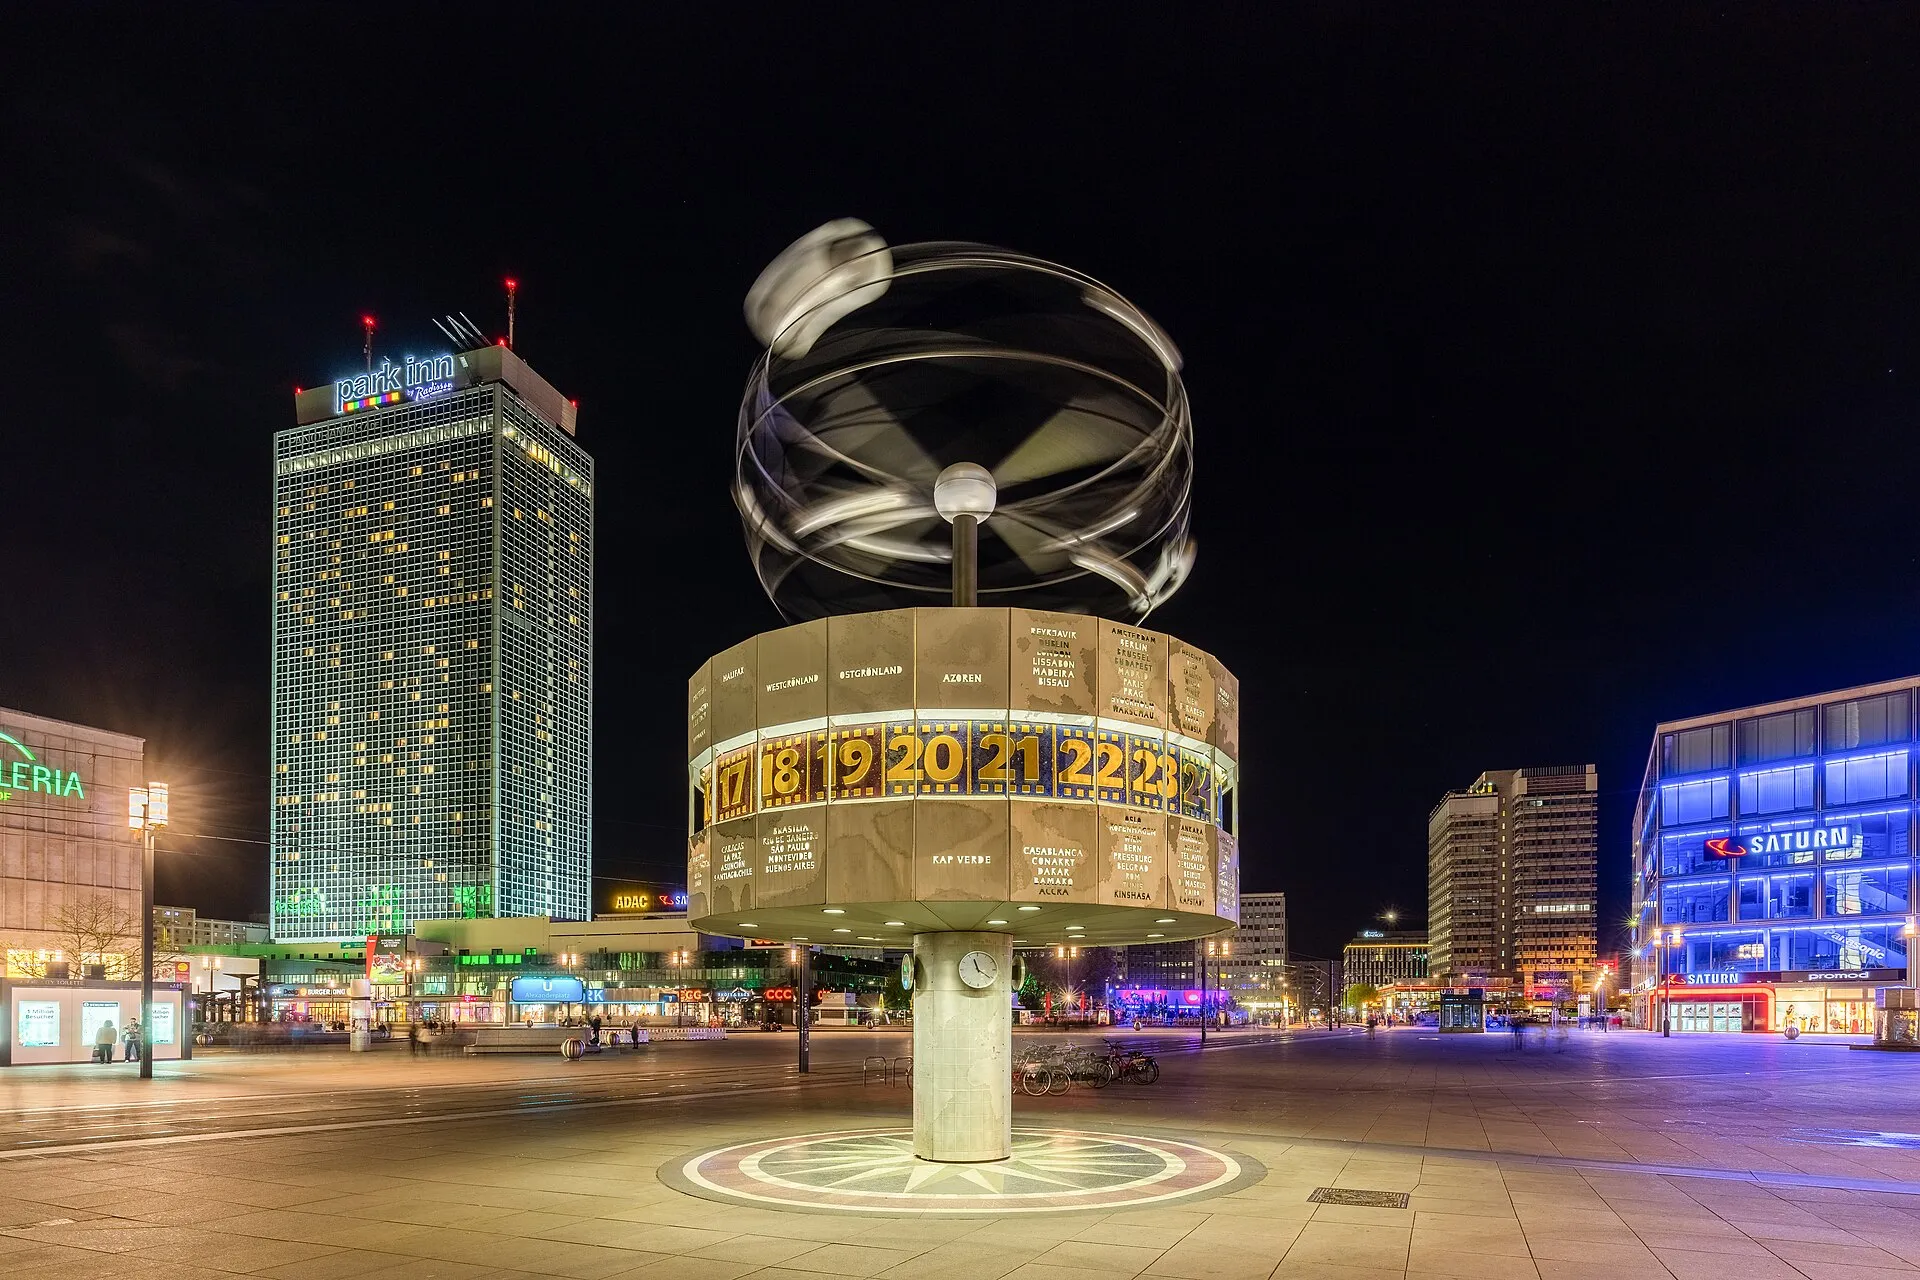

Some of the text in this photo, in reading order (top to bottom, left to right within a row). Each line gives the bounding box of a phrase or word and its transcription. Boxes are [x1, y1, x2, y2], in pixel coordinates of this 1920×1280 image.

[336, 355, 454, 413] park inn
[415, 382, 454, 401] Radisson
[1111, 627, 1156, 643] AMSTERDAM
[1039, 638, 1069, 648] DUBLIN
[1120, 639, 1148, 652] BERLIN
[1037, 650, 1071, 658] LONDON
[1032, 657, 1075, 669] LISSABON
[1114, 657, 1153, 672] BUDAPEST
[722, 667, 744, 682] HALIFAX
[839, 665, 903, 680] OSTGRÖNLAND
[942, 673, 982, 683] AZOREN
[1032, 667, 1075, 678] MADEIRA
[1118, 667, 1148, 680] MADRID
[766, 674, 819, 692] WESTGRÖNLAND
[1038, 677, 1070, 687] BISSAU
[1123, 677, 1144, 688] PARIS
[1123, 687, 1144, 698] PRAG
[1111, 695, 1155, 711] STOCKHOLM
[1112, 705, 1154, 719] WARSCHAU
[1180, 702, 1205, 718] BKAREST
[817, 739, 873, 787] 19
[886, 734, 963, 782] 20
[978, 734, 1040, 781] 21
[1058, 738, 1124, 789] 22
[762, 748, 800, 797] 18
[1132, 749, 1178, 799] 23
[720, 760, 747, 808] 17
[1109, 823, 1157, 836] KOPENHAGEN
[1181, 824, 1204, 835] ANKARA
[1751, 826, 1848, 853] SATURN
[771, 842, 810, 854] SÃO PAULO
[1023, 846, 1084, 857] CASABLANCA
[1124, 843, 1142, 853] BERN
[723, 851, 742, 863] LA PAZ
[768, 851, 813, 863] MONTEVIDEO
[932, 855, 991, 864] KAP VERDE
[1031, 857, 1075, 866] CONAKRY
[1113, 852, 1153, 864] PRESSBURG
[1181, 852, 1190, 860] TEL
[765, 861, 815, 873] BUENOS AIRES
[1037, 867, 1069, 876] DAKAR
[1117, 862, 1149, 873] BELGRAD
[1033, 877, 1073, 886] BAMAKO
[1125, 872, 1140, 880] ROM
[1039, 888, 1069, 896] ACCRA
[1114, 890, 1152, 900] KINSHASA
[615, 895, 648, 909] ADAC
[1823, 928, 1886, 960] Panasonic
[1687, 973, 1739, 984] SATURN
[1808, 971, 1869, 981] promod
[542, 980, 553, 991] U
[765, 988, 792, 1000] CCC
